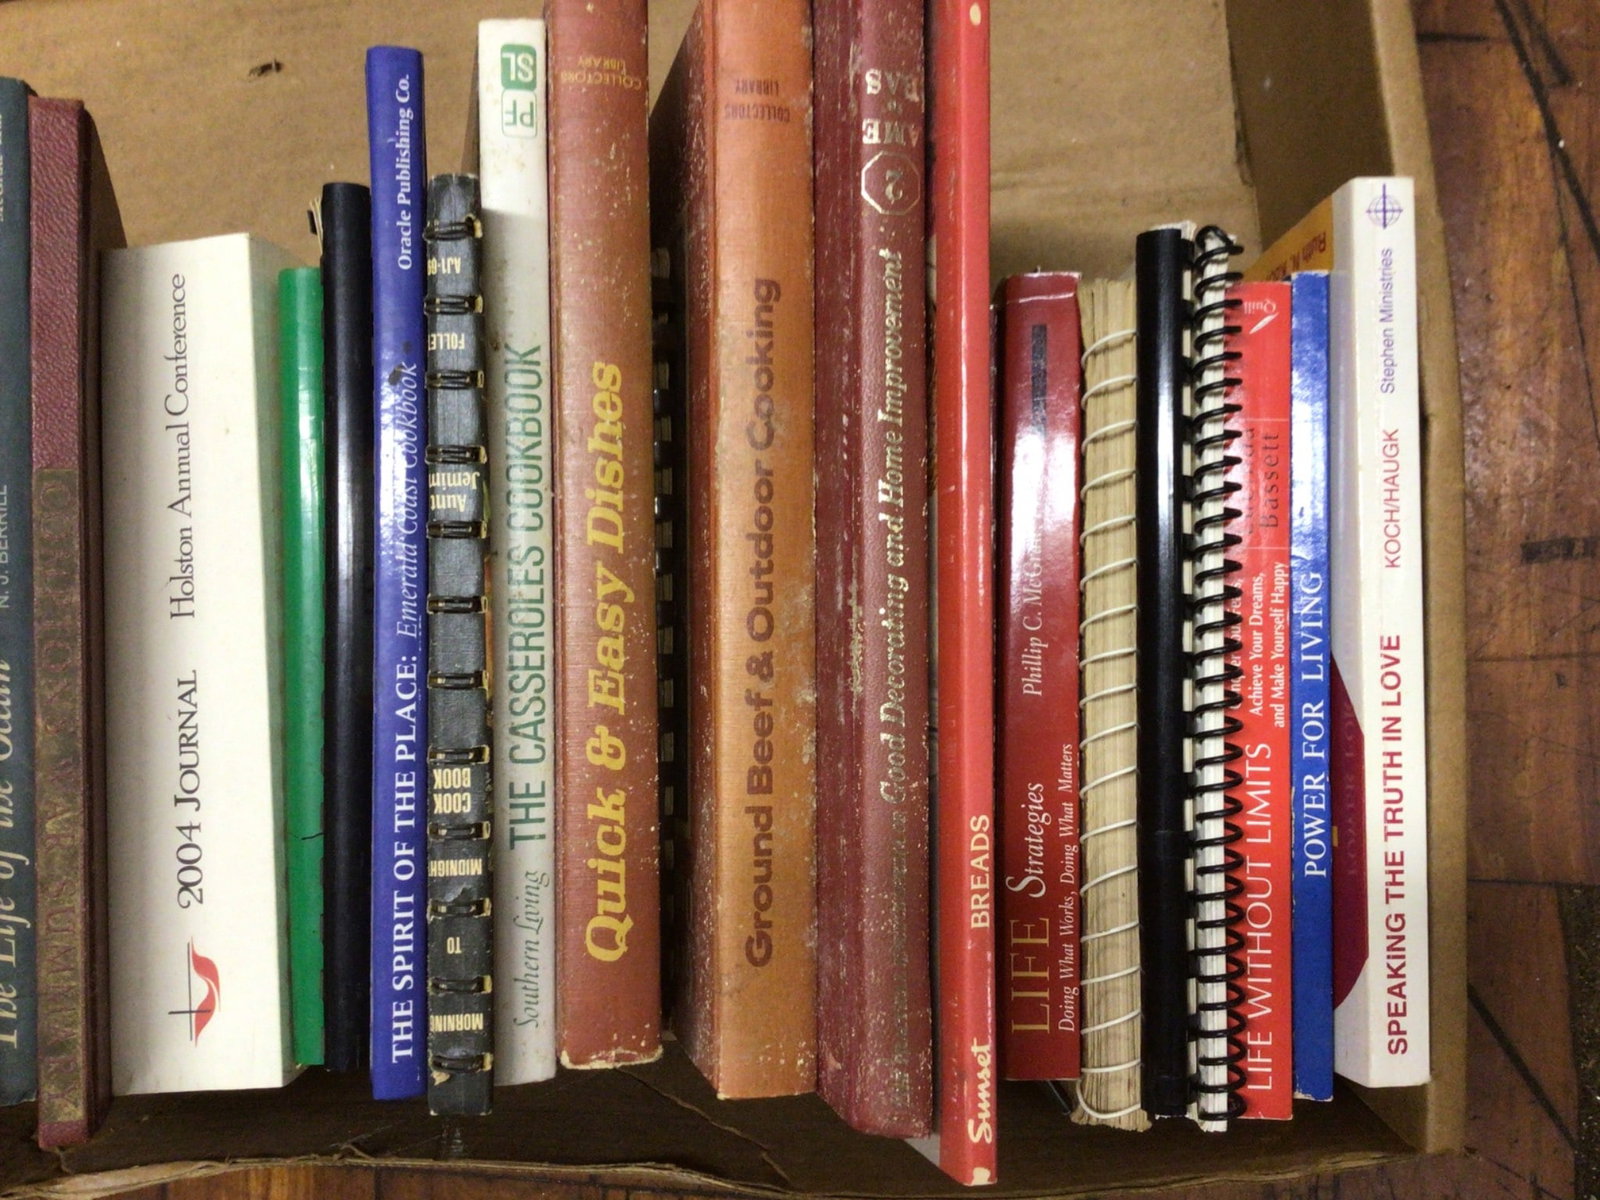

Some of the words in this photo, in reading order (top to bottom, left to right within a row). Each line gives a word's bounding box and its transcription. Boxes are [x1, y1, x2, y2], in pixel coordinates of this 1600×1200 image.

[395, 74, 410, 103] Co.
[502, 52, 534, 82] SL
[735, 78, 779, 97] LIBRARY
[505, 99, 534, 128] PF
[724, 103, 790, 122] COLLECTORS
[395, 107, 414, 206] Publishing
[884, 170, 903, 205] 2
[397, 210, 411, 270] Oracle
[1244, 298, 1276, 314] Quill
[1379, 248, 1394, 323] Ministries
[164, 273, 190, 418] Conference
[746, 278, 781, 450] Cooking
[878, 247, 907, 426] Improvement
[1380, 326, 1397, 394] Stephen
[395, 362, 418, 470] Cookbook
[504, 345, 544, 532] COOKBOOK
[166, 421, 192, 517] Annual
[429, 471, 480, 491] Jemim
[585, 361, 625, 554] Dishes
[878, 431, 904, 508] Home
[1259, 432, 1279, 528] Bassett
[396, 476, 419, 536] Coast
[431, 494, 468, 512] Aunt
[1382, 428, 1401, 568] KOCH/HAUGK
[169, 526, 195, 619] Holston
[746, 460, 774, 641] Outdoor
[879, 513, 905, 567] and
[396, 541, 419, 639] Emerald
[1249, 573, 1266, 626] Dreams,
[1271, 562, 1289, 604] Happy
[587, 561, 635, 716] Easy
[879, 572, 909, 727] Decorating
[1023, 611, 1042, 631] C.
[1249, 630, 1264, 660] Your
[1270, 608, 1285, 660] Yourself
[1299, 571, 1324, 682] LIVING
[507, 545, 546, 766] CASSEROLES
[746, 650, 774, 683] &
[1022, 636, 1048, 696] Phillip
[1270, 663, 1285, 699] Make
[1380, 634, 1401, 706] LOVE
[395, 655, 417, 762] PLACE:
[1248, 664, 1264, 716] Achieve
[1270, 700, 1285, 728] and
[174, 670, 202, 811] JOURNAL
[585, 725, 627, 771] &
[745, 689, 773, 795] Beef
[1302, 699, 1325, 760] FOR
[1382, 715, 1402, 741] IN
[433, 767, 471, 789] BOOK
[880, 733, 906, 803] Good
[1057, 743, 1074, 793] Matters
[1245, 742, 1272, 843] LIMITS
[1382, 751, 1404, 842] TRUTH
[394, 771, 416, 833] THE
[433, 792, 471, 814] COOK
[509, 781, 546, 850] THE
[1059, 801, 1075, 838] What
[1303, 772, 1328, 878] POWER
[175, 821, 204, 909] 2004
[393, 841, 416, 880] OF
[428, 857, 482, 877] MIDNIGH
[970, 814, 990, 929] BREADS
[1006, 782, 1052, 898] Strategies
[1059, 844, 1079, 884] Doing
[513, 871, 549, 937] Living
[585, 787, 634, 962] Quick
[745, 806, 773, 968] Ground
[1384, 850, 1405, 905] THE
[392, 891, 415, 990] SPIRIT
[446, 936, 461, 955] TO
[1059, 891, 1077, 937] Works,
[1245, 856, 1273, 1019] WITHOUT
[513, 940, 540, 1028] Southern
[1009, 917, 1051, 1035] LIFE
[1059, 942, 1075, 979] What
[1386, 913, 1408, 1054] SPEAKING
[46, 878, 76, 1112] SUMMARY
[1058, 985, 1080, 1032] Doing
[392, 1000, 414, 1063] THE
[1246, 1031, 1273, 1091] LIFE
[968, 1037, 993, 1145] Sunset
